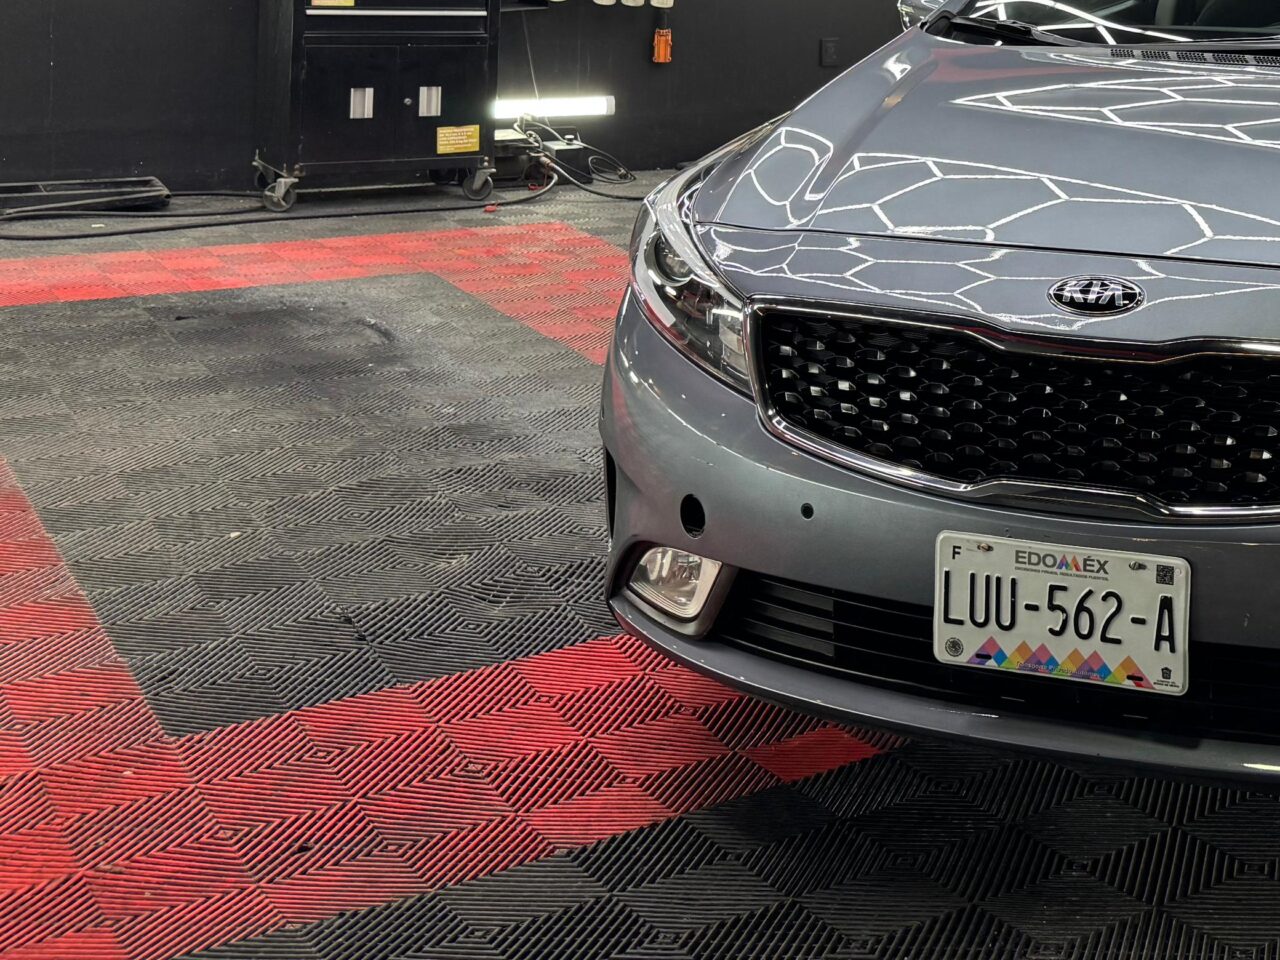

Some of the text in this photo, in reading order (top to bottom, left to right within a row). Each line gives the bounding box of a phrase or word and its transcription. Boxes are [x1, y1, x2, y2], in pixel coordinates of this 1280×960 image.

[1062, 280, 1123, 306] KIA
[951, 545, 962, 560] F
[1015, 549, 1109, 575] EDOMÉX
[943, 568, 1176, 654] LUU-562-A
